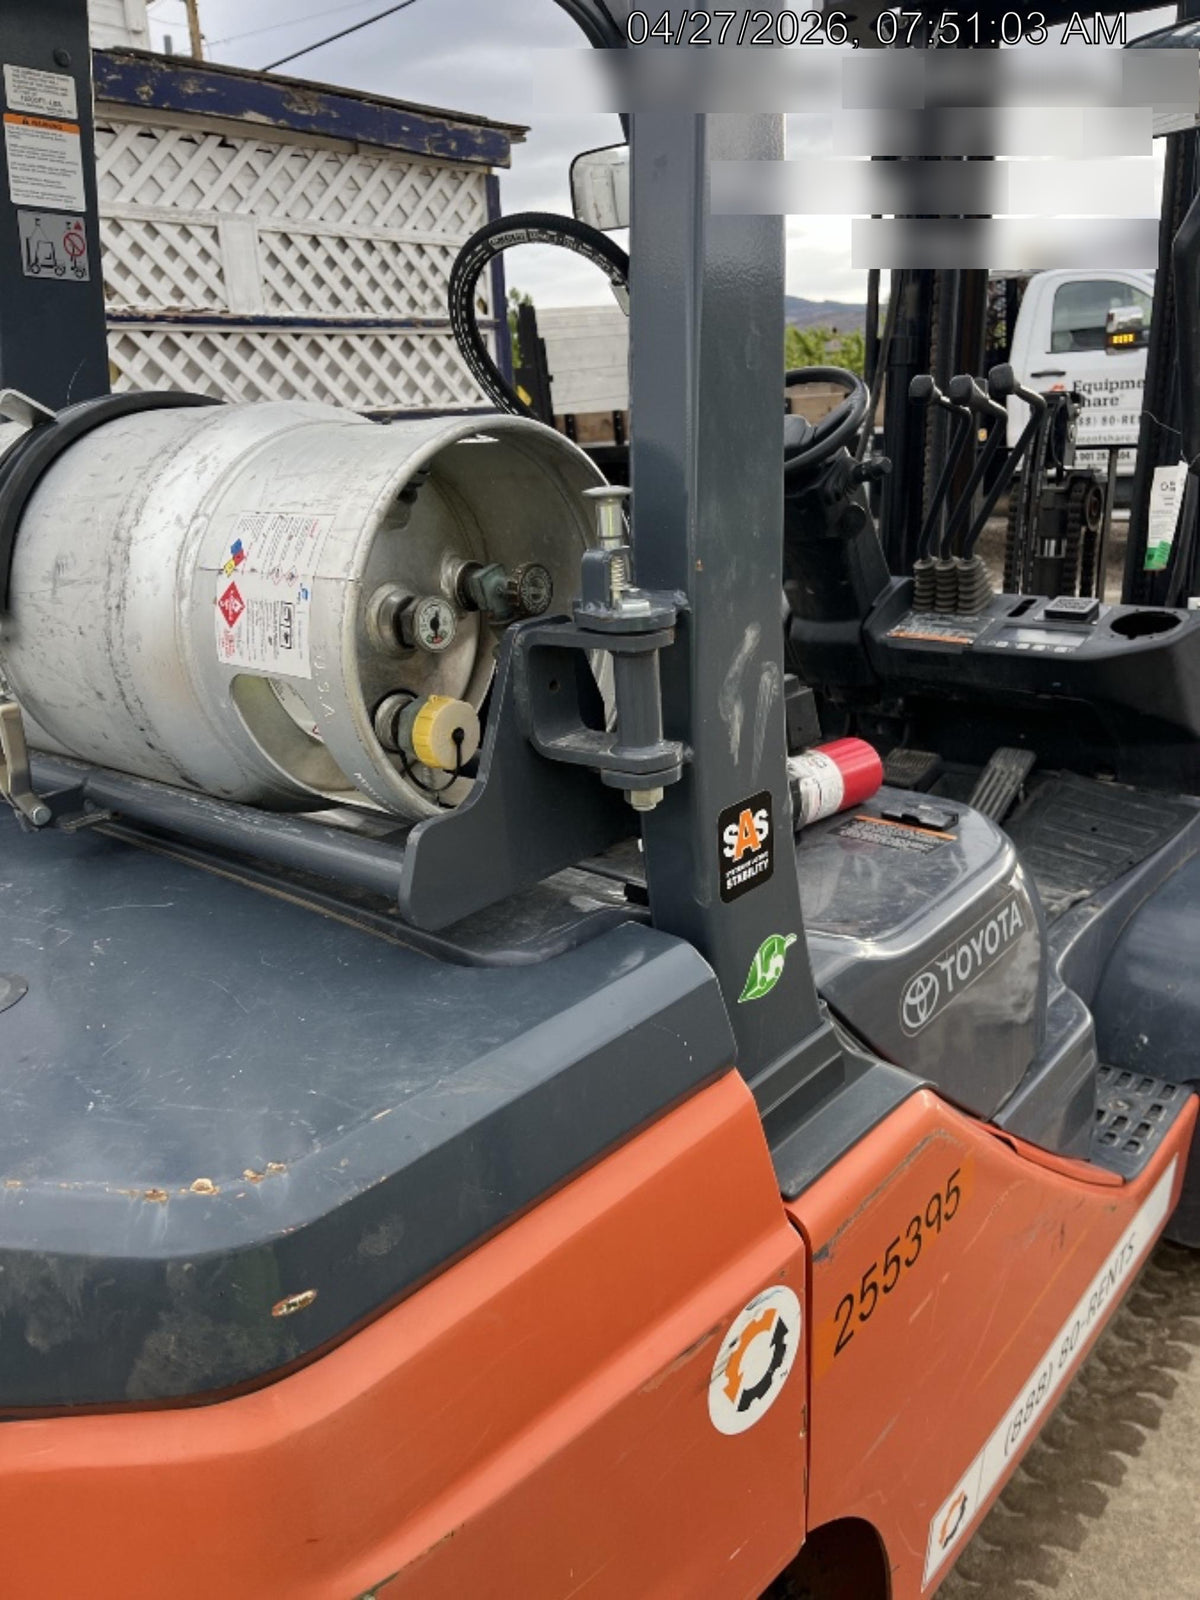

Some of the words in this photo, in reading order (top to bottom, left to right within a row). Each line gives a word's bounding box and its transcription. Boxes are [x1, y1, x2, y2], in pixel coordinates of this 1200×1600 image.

[1081, 396, 1120, 408] hare
[723, 808, 770, 863] SAS
[726, 857, 769, 890] STABILITY
[937, 901, 1025, 993] TOYOTA
[834, 1168, 961, 1358] 255395
[1004, 1362, 1053, 1457] (888)
[1058, 1232, 1137, 1370] 80-RENTS
